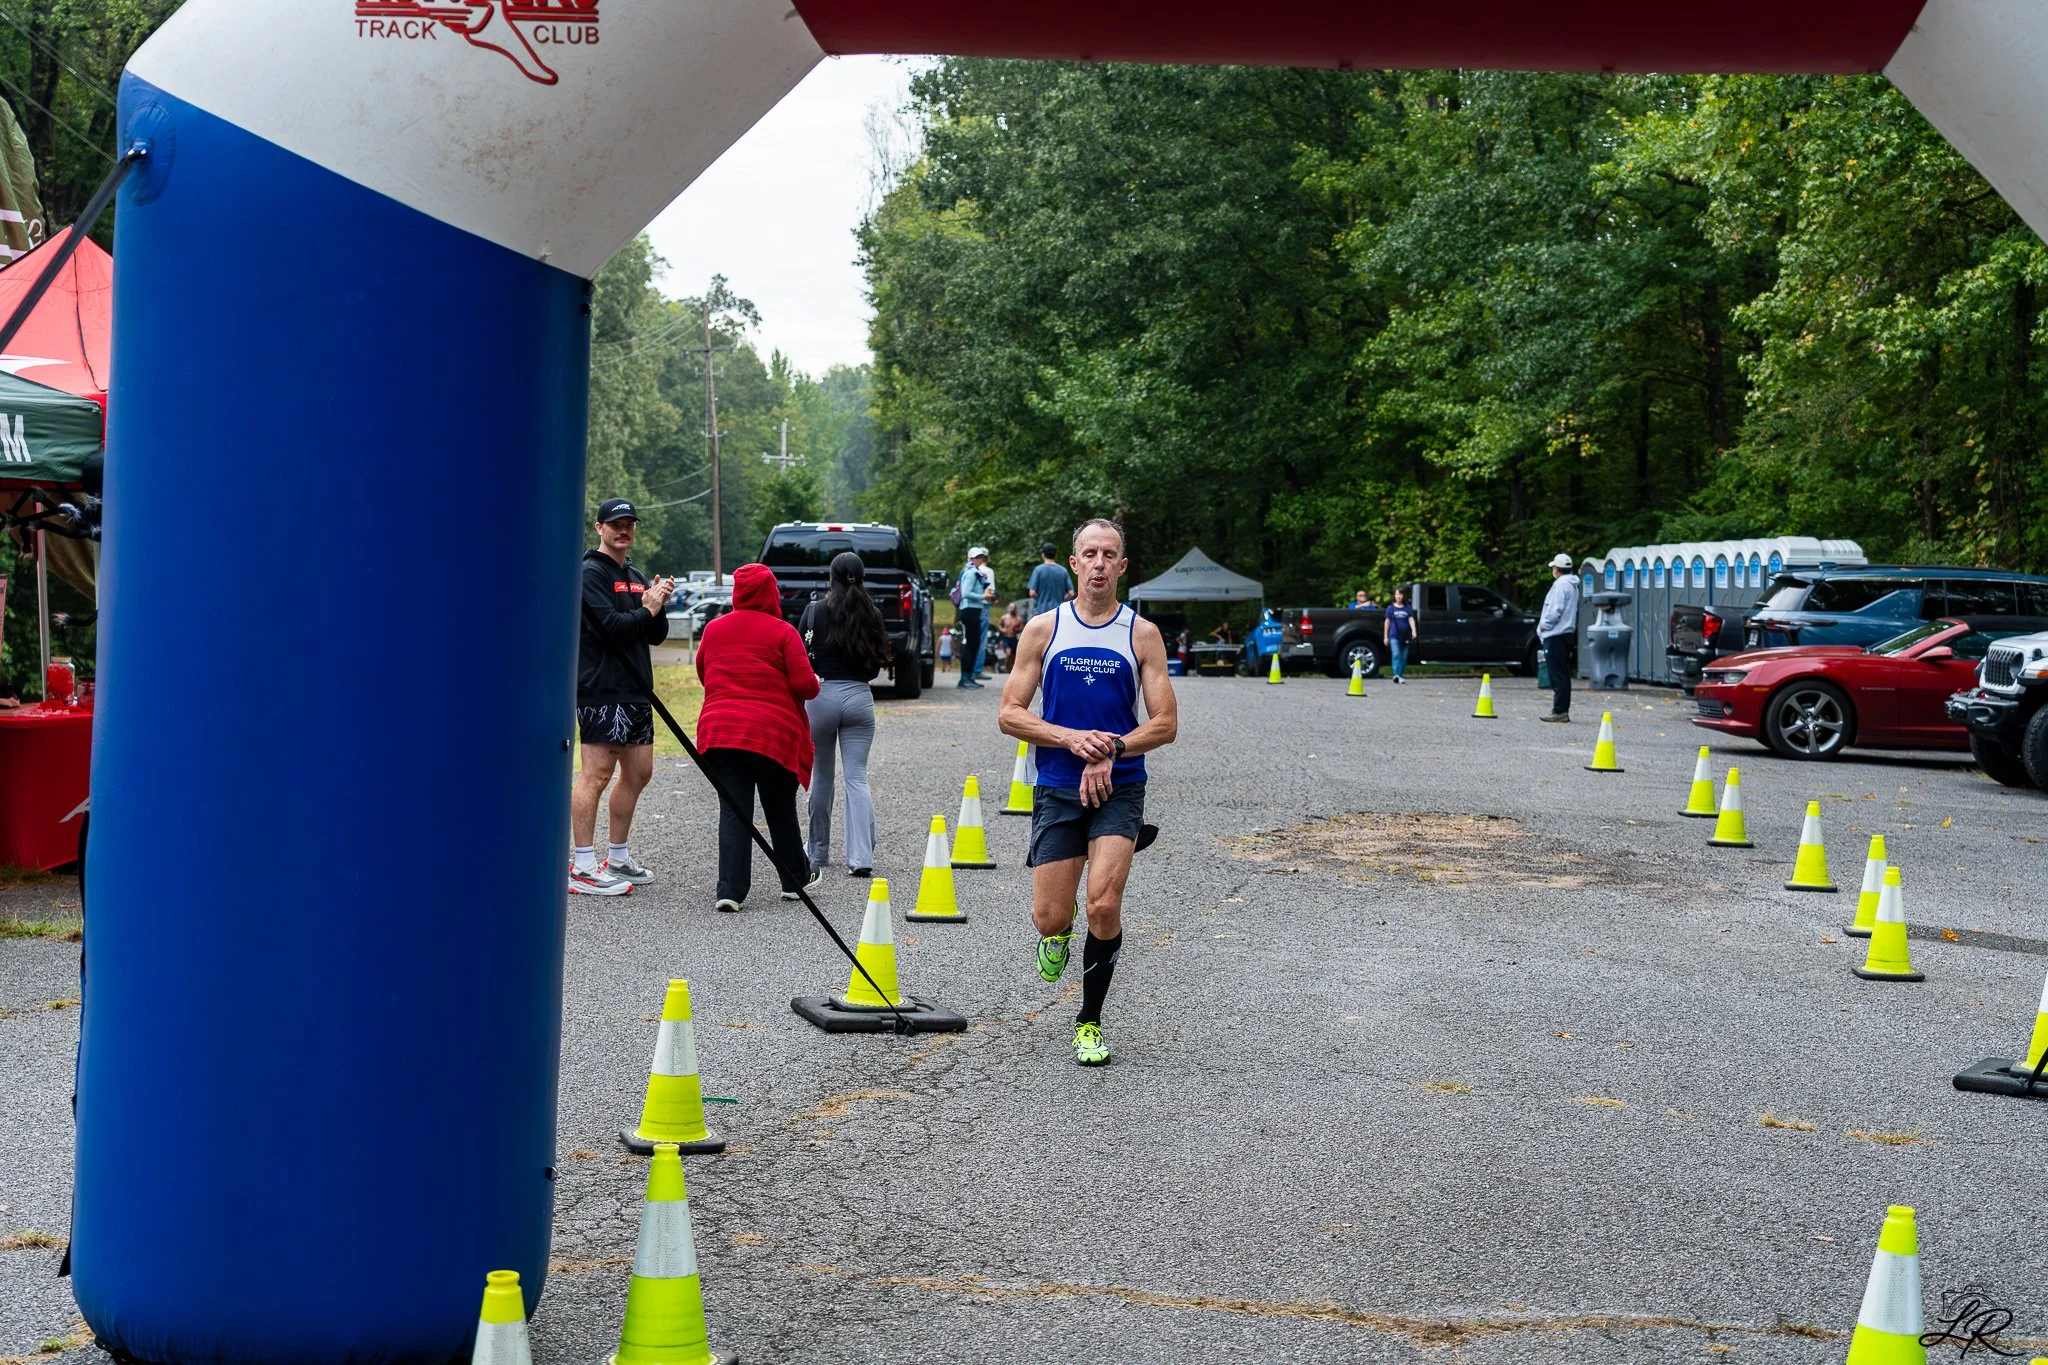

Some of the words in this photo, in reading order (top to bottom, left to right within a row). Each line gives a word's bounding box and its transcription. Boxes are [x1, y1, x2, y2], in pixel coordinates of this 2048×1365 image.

[355, 19, 437, 40] TRACK
[533, 24, 600, 45] CLUB
[1064, 665, 1091, 673] TRACK
